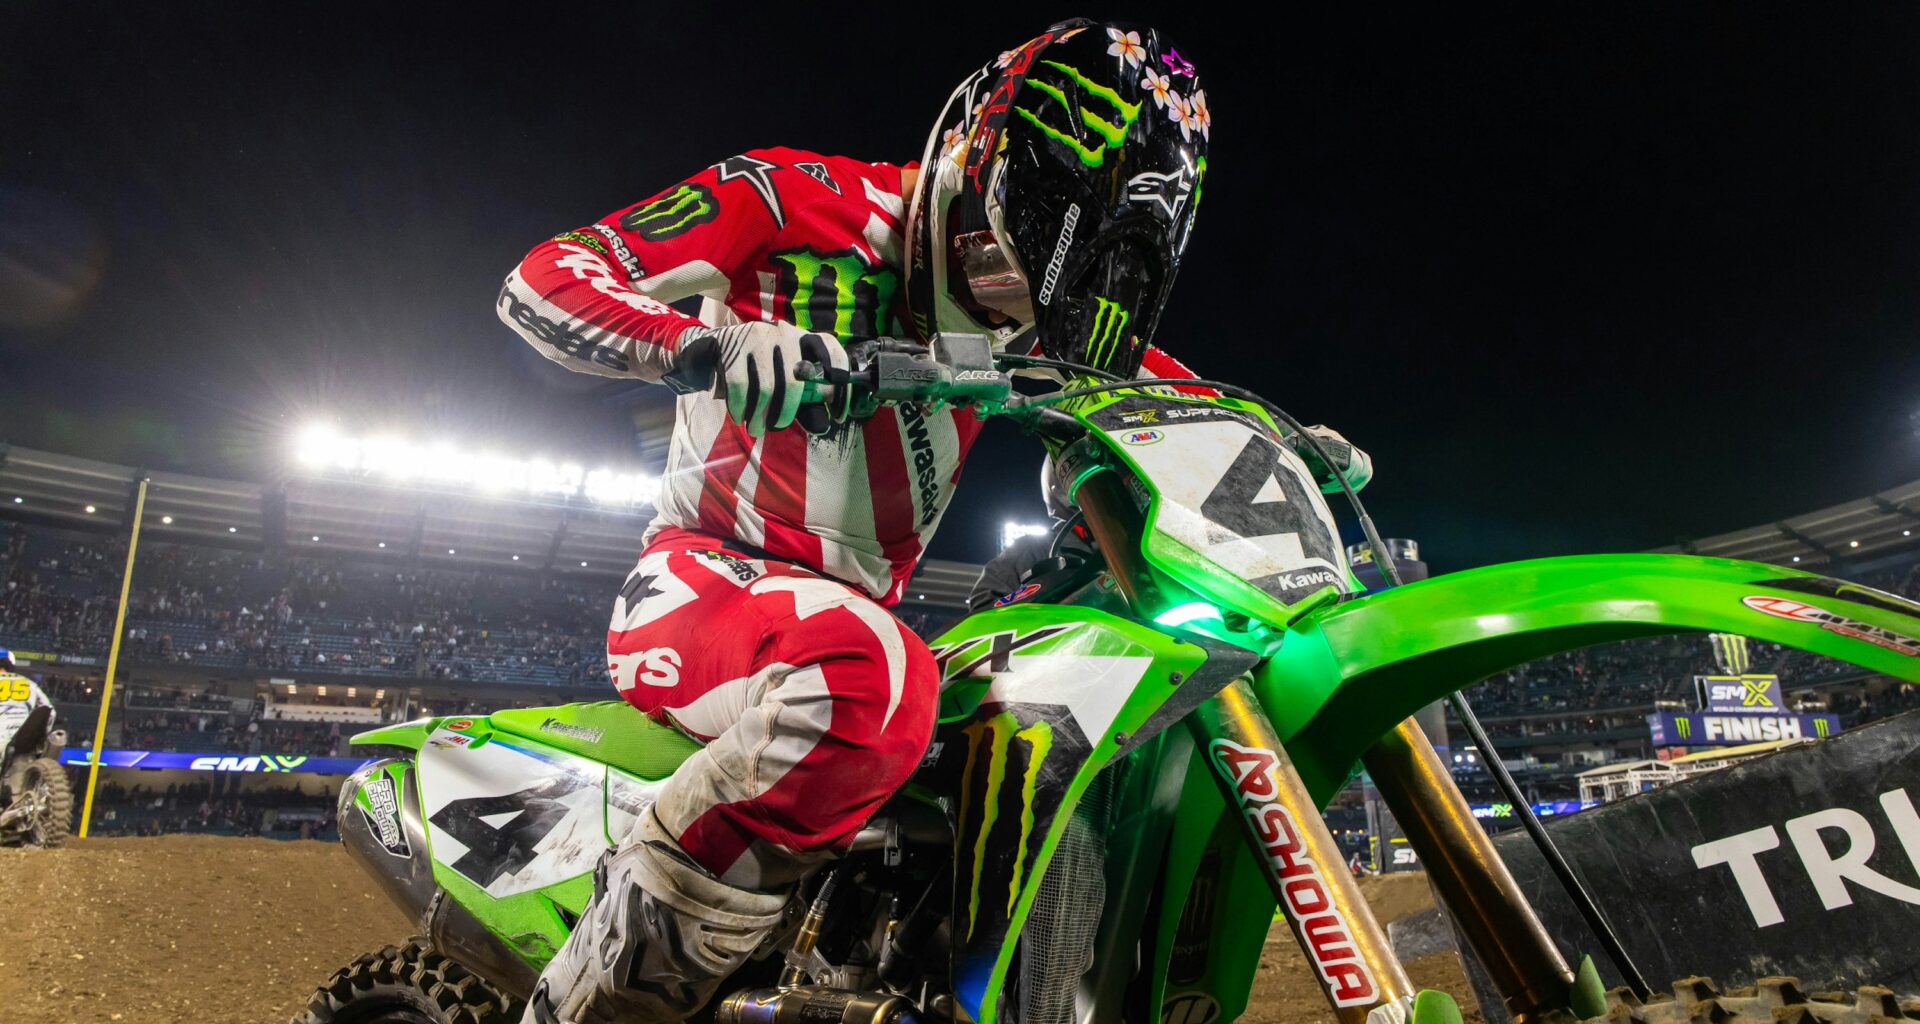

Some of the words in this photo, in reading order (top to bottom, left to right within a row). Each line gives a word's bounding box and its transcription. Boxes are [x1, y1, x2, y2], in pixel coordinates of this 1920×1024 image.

[955, 370, 999, 381] ARC
[899, 400, 940, 525] awasaki
[1130, 431, 1158, 443] AMA
[1199, 433, 1338, 567] 4
[1711, 681, 1774, 706] SMX
[1703, 716, 1801, 741] FINISH
[428, 795, 572, 888] 4
[1249, 806, 1377, 1004] SHOWA
